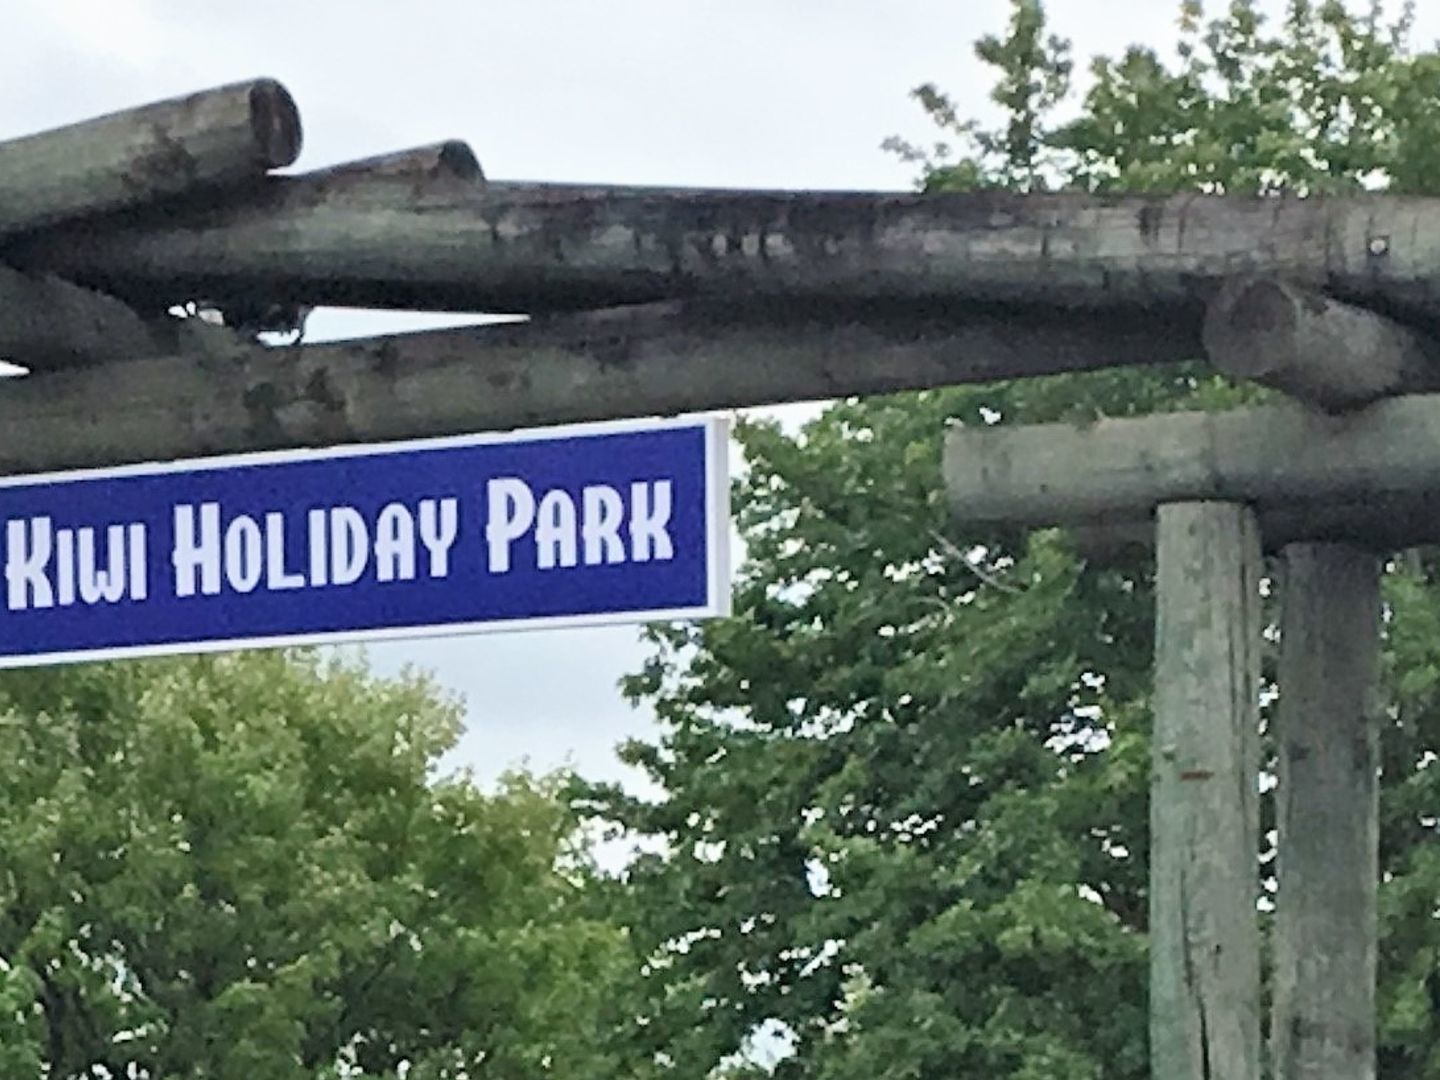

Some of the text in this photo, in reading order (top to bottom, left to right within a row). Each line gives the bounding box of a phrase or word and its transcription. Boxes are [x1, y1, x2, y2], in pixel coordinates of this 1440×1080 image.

[5, 516, 147, 610] KIWI
[172, 498, 458, 597] HOLIDAY
[485, 478, 674, 573] PARK
